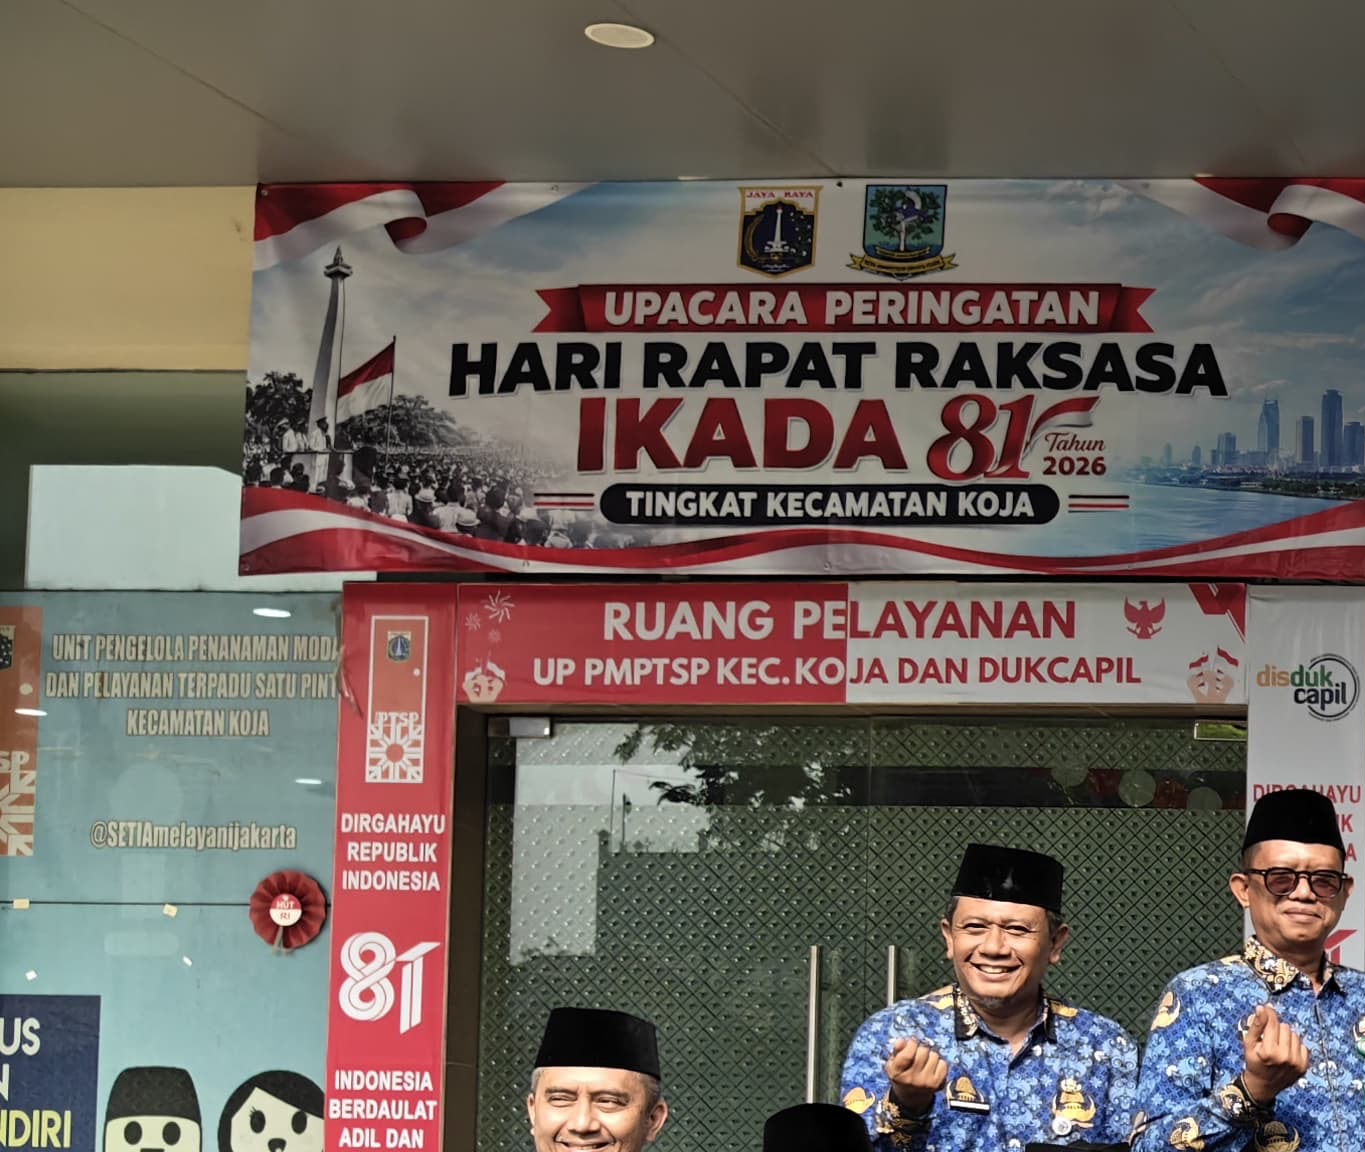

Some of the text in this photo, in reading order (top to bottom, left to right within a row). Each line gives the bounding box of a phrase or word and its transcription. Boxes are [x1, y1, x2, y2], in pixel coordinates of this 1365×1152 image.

[604, 290, 1099, 325] UPACARA PERINGATAN
[449, 341, 1228, 397] HARI RAPAT RAKSASA
[577, 394, 1036, 480] IKADA 81
[1045, 432, 1106, 452] Tahun
[1042, 456, 1107, 476] 2026
[626, 491, 1035, 517] TINGKAT KECAMATAN KOJA
[603, 601, 1075, 640] RUANG PELAYANAN
[53, 635, 338, 662] UNIT PENGELOLA PENANAMAN MODA
[533, 657, 1141, 686] UP PMPTSP KEC. KOJA DAN DUKCAPIL
[46, 672, 338, 698] DAN PELAYANAN TERPADU SATU PINT
[1294, 682, 1347, 712] capil
[127, 709, 270, 736] KECAMATAN KOJA
[90, 821, 297, 851] @SETIAmelayanijakarta
[341, 813, 446, 834] DIRGAHAYU
[347, 842, 437, 862] REPUBLIK
[342, 870, 440, 891] INDONESIA
[339, 931, 441, 1035] 81
[335, 1070, 433, 1091] INDONESIA
[329, 1099, 437, 1120] BERDAULAT
[339, 1128, 424, 1149] ADIL DAN
